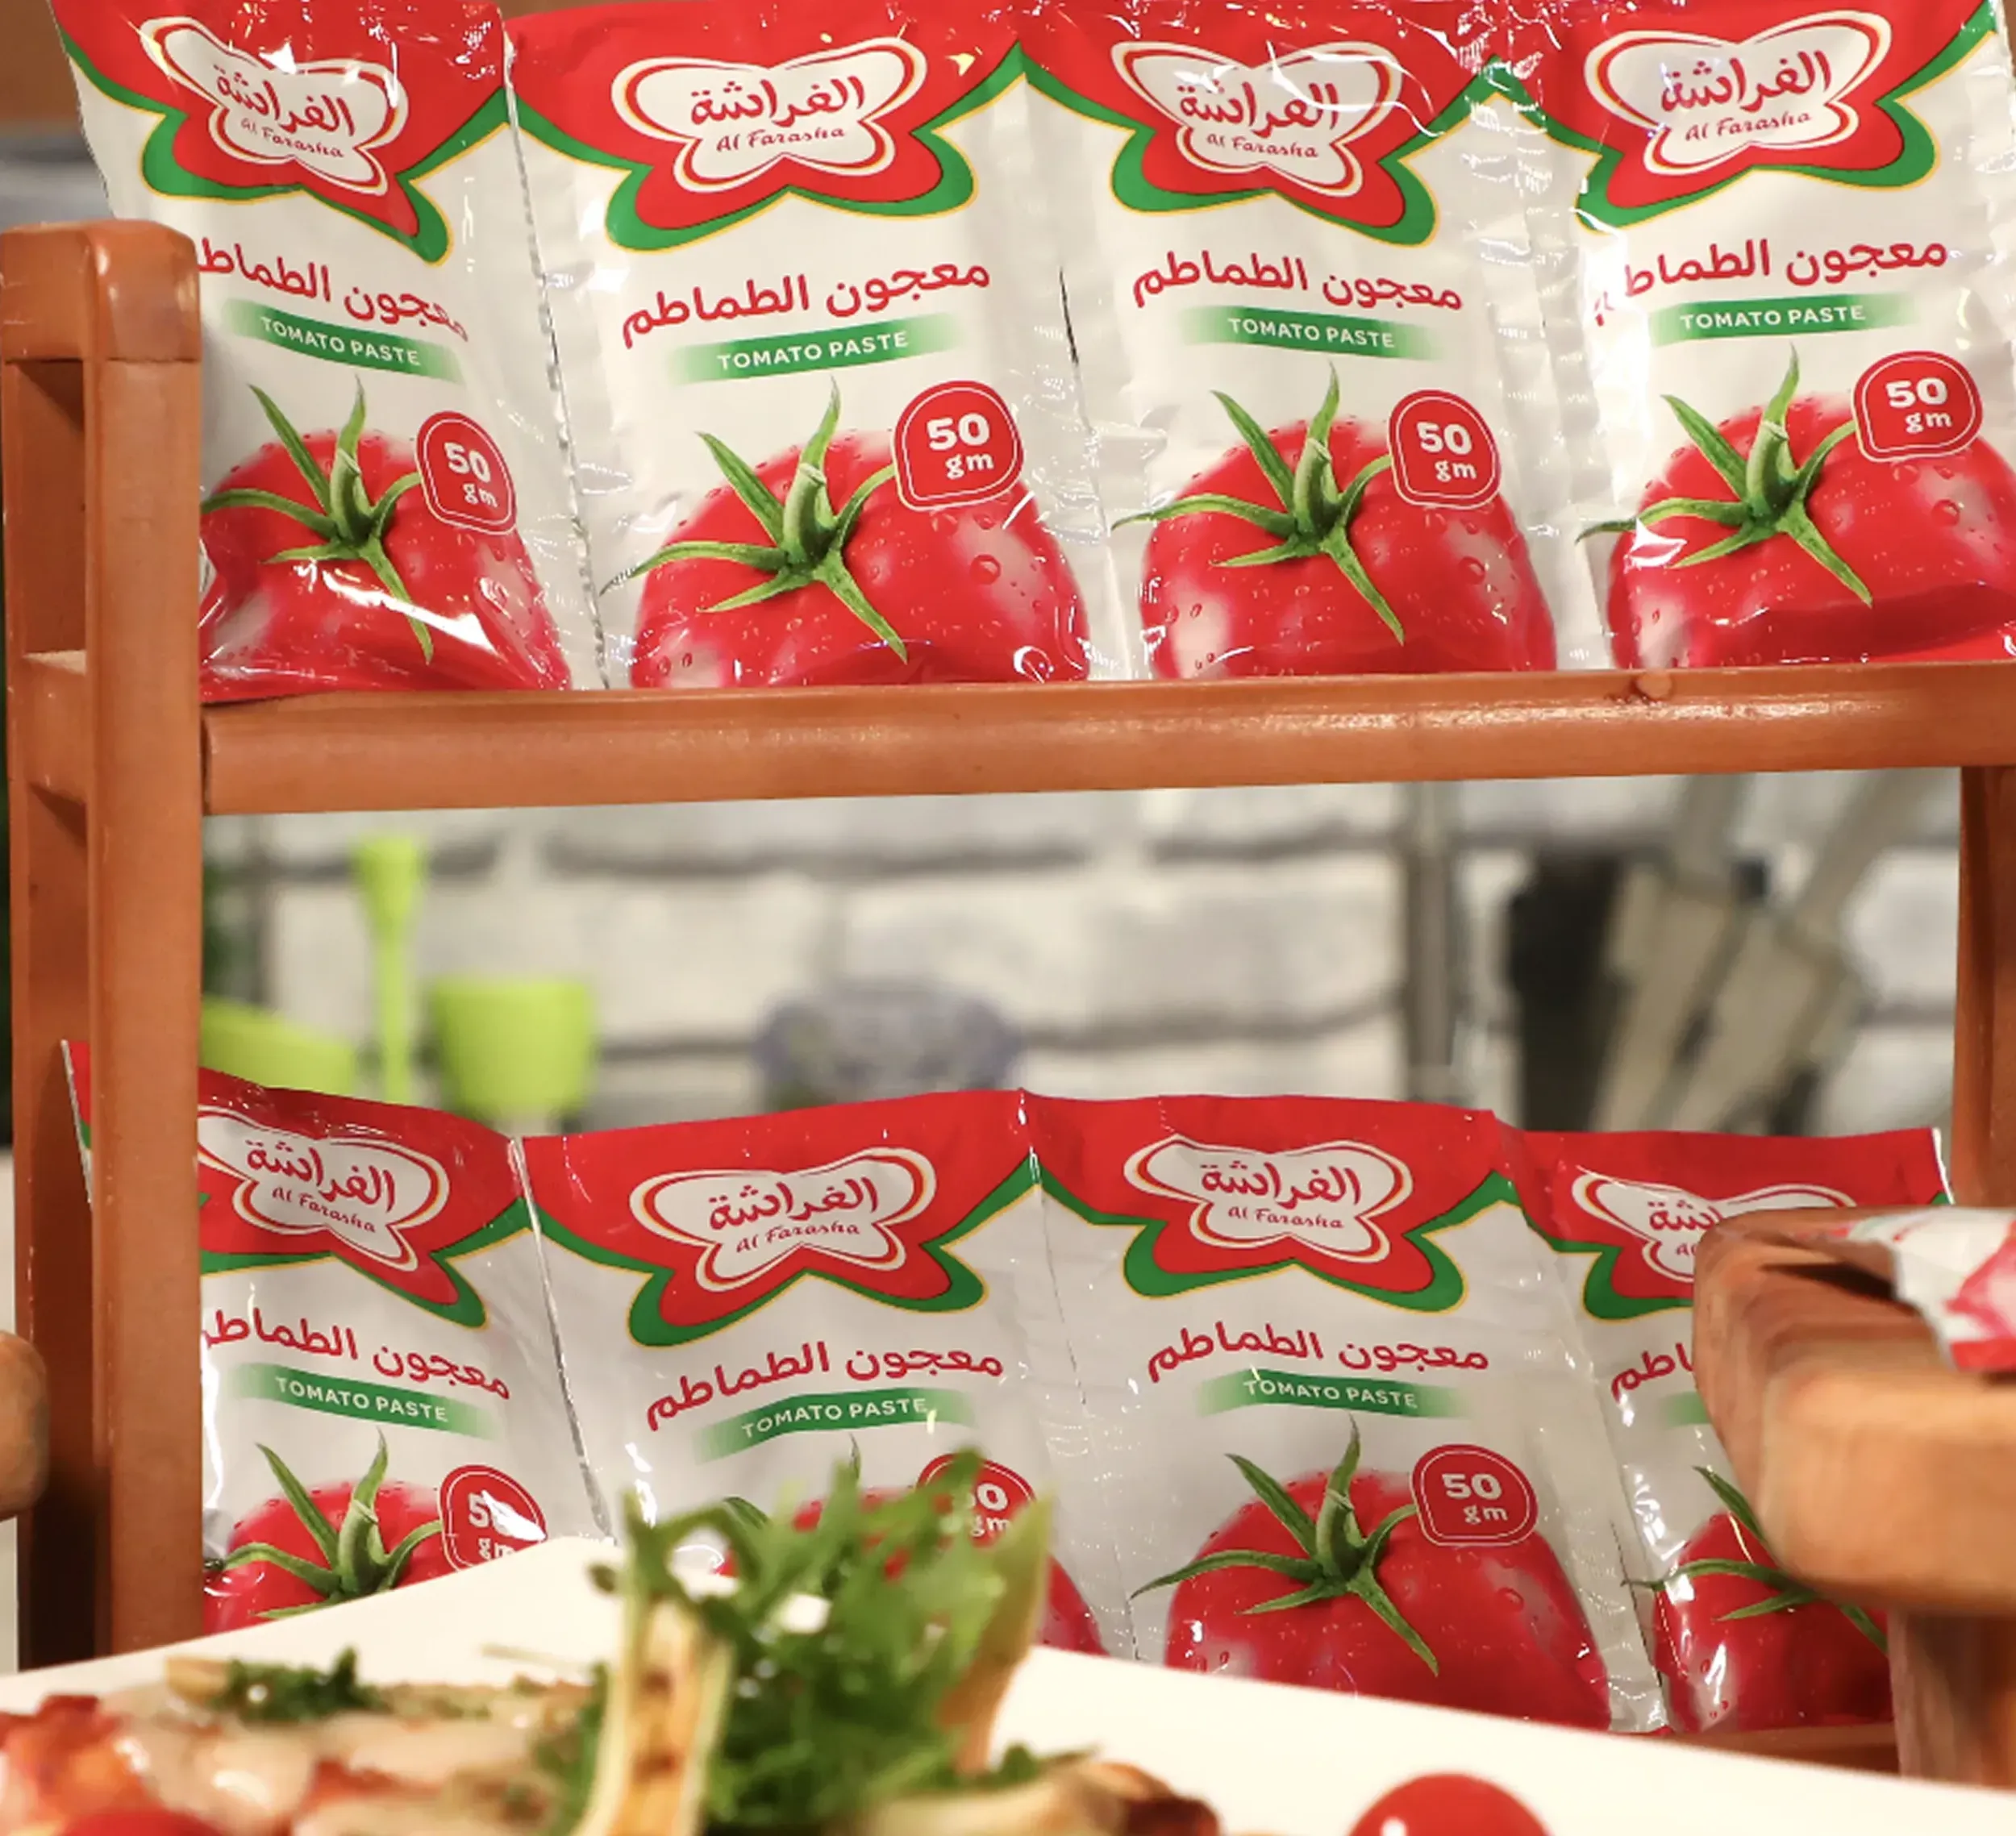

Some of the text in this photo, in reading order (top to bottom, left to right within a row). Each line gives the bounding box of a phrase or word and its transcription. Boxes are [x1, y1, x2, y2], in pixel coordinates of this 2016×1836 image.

[214, 64, 355, 136] الفراشة
[691, 76, 865, 127] الفراشة
[1660, 50, 1833, 113] الفراشة
[241, 118, 344, 158] Al Farasha
[716, 126, 844, 152] Al Farasha
[1206, 132, 1318, 158] Al Farasha
[1685, 112, 1811, 141] Al Farasha
[1133, 250, 1464, 310] معجون الطماطم
[1785, 242, 1947, 286] معجون
[198, 238, 468, 342] معجون الطماط
[622, 260, 989, 348] معجون الطماطم
[1229, 318, 1395, 348] TOMATO PASTE
[1680, 305, 1866, 330] TOMATO PASTE
[260, 316, 421, 366] TOMATO PASTE
[717, 331, 908, 369] TOMATO PASTE
[1885, 377, 1947, 409] 50
[926, 412, 990, 452] 50
[1416, 422, 1472, 455] 50
[1905, 412, 1953, 434] gm
[444, 441, 491, 482] 50
[945, 453, 994, 480] gm
[1435, 458, 1477, 482] gm
[464, 483, 498, 508] gm
[246, 1139, 396, 1213] الفراشة
[1201, 1160, 1361, 1209] الفراشة
[272, 1185, 376, 1234] Al Farasha
[709, 1176, 878, 1230] الفراشة
[1228, 1206, 1343, 1229] Al Farasha
[737, 1221, 860, 1254] Al Farasha
[202, 1308, 510, 1400] معجون الطماط
[1148, 1322, 1489, 1383] معجون الطماطم
[275, 1376, 449, 1423] TOMATO PASTE
[646, 1341, 1004, 1432] معجون الطماطم
[1243, 1379, 1417, 1408] TOMATO PASTE
[742, 1398, 927, 1438] TOMATO PASTE
[968, 1482, 1008, 1513] 0
[1442, 1473, 1502, 1500] 50
[1464, 1503, 1508, 1524] gm
